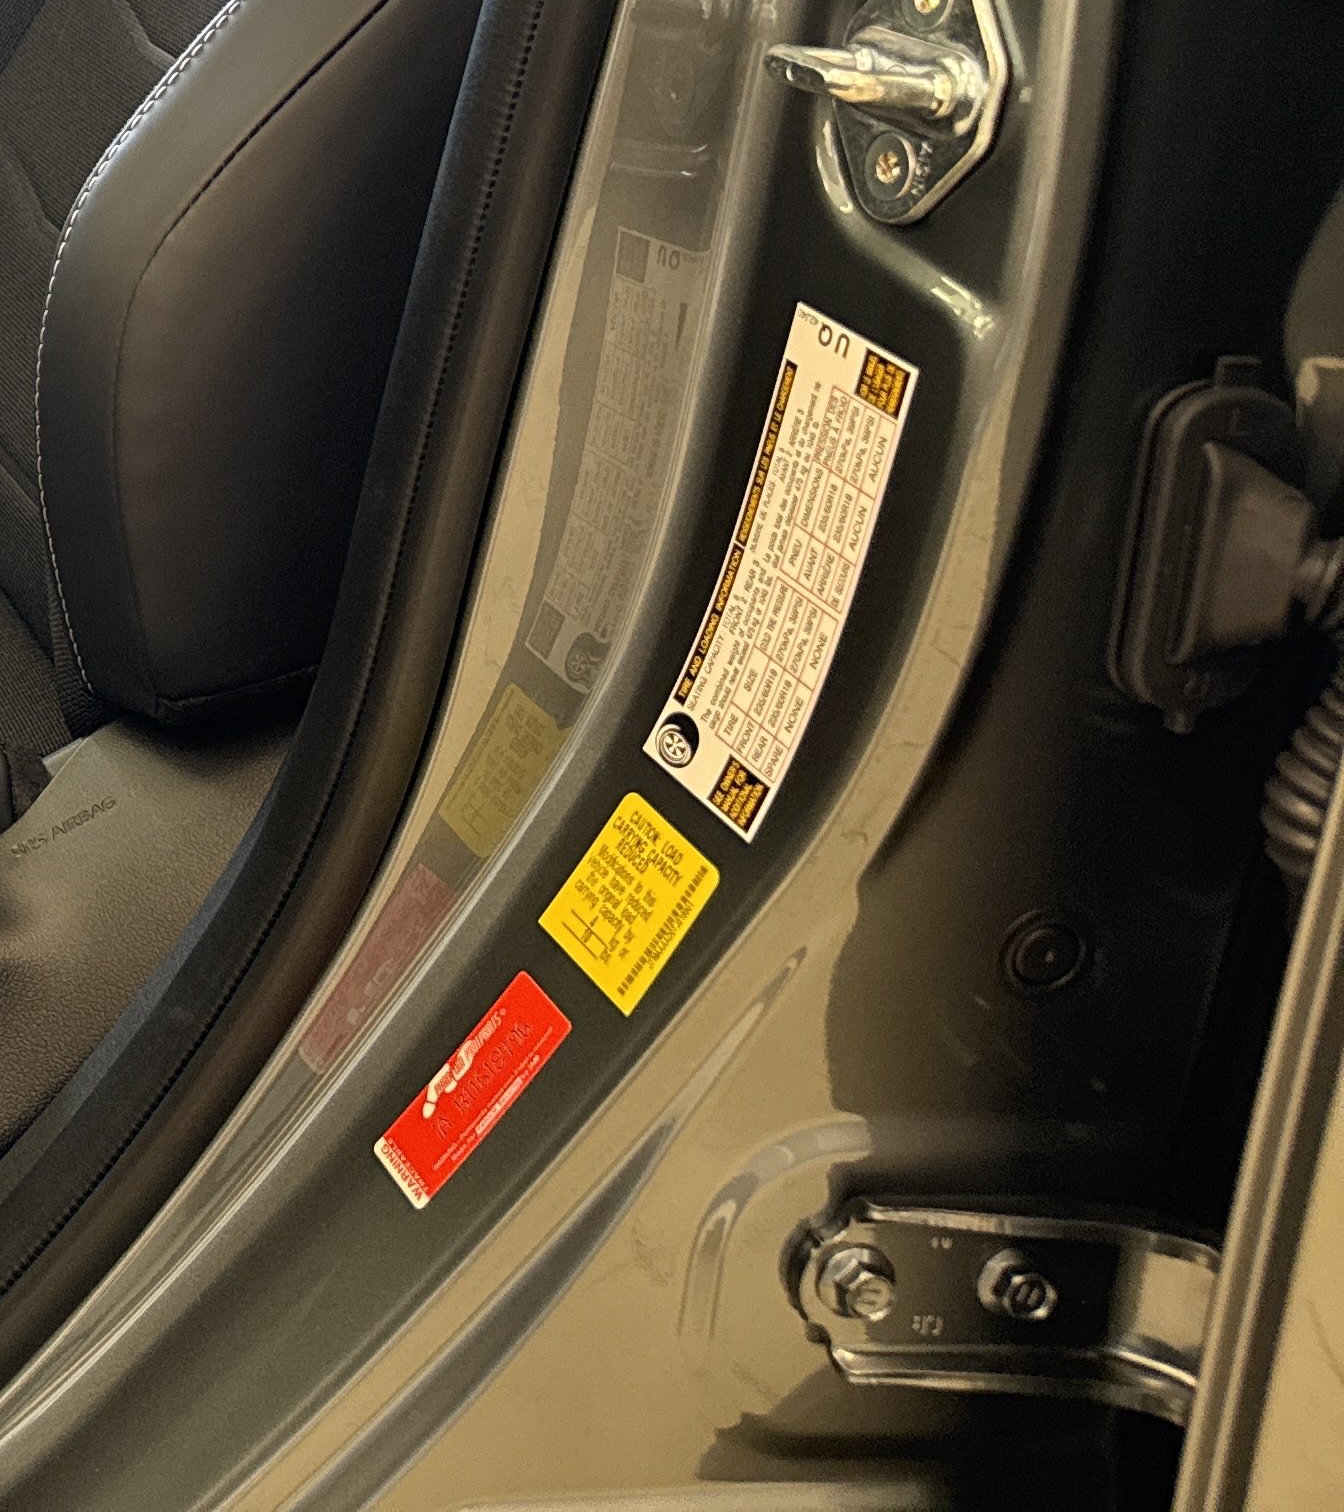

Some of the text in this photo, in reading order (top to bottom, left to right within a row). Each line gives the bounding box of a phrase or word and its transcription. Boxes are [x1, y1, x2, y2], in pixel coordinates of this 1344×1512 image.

[826, 394, 838, 415] DES
[759, 455, 769, 470] LES
[763, 431, 775, 455] PNEUS
[755, 469, 765, 485] SUR
[777, 457, 789, 483] AVANT
[787, 537, 801, 567] PNEU
[798, 465, 823, 528] DIMENSIONS
[821, 434, 836, 467] PNEUS
[833, 395, 848, 424] FROID
[846, 503, 866, 552] AUCUN
[866, 434, 887, 483] AUCUN
[801, 545, 818, 582] AVANT
[812, 550, 833, 596] ARRIÈRE
[728, 605, 743, 635] FRONT
[744, 568, 756, 592] REAR
[752, 558, 759, 567] 3
[678, 549, 741, 698] TIRE AND LOADING INFORMATION
[700, 566, 767, 723] The combined weight of occupants and
[687, 603, 735, 711] SEATING CAPACITY TOTAL
[709, 709, 721, 730] cargo
[716, 685, 731, 709] should
[728, 665, 739, 685] never
[736, 640, 749, 665] exceed
[755, 607, 761, 616] or
[723, 711, 737, 736] TIRE
[742, 666, 758, 692] SIZE
[763, 630, 828, 778] SPARE NONE NONE
[735, 719, 755, 754] FRONT
[750, 734, 767, 763] REAR
[712, 790, 724, 805] SEE
[734, 768, 747, 786] FOR
[52, 795, 116, 839] AIRBAG
[629, 808, 663, 846] CAUTION:
[660, 840, 684, 867] LOAD
[612, 813, 650, 854] CARRYING
[646, 847, 682, 887] CAPACITY
[615, 836, 650, 875] REDUCED
[379, 1142, 424, 1201] WARNING
